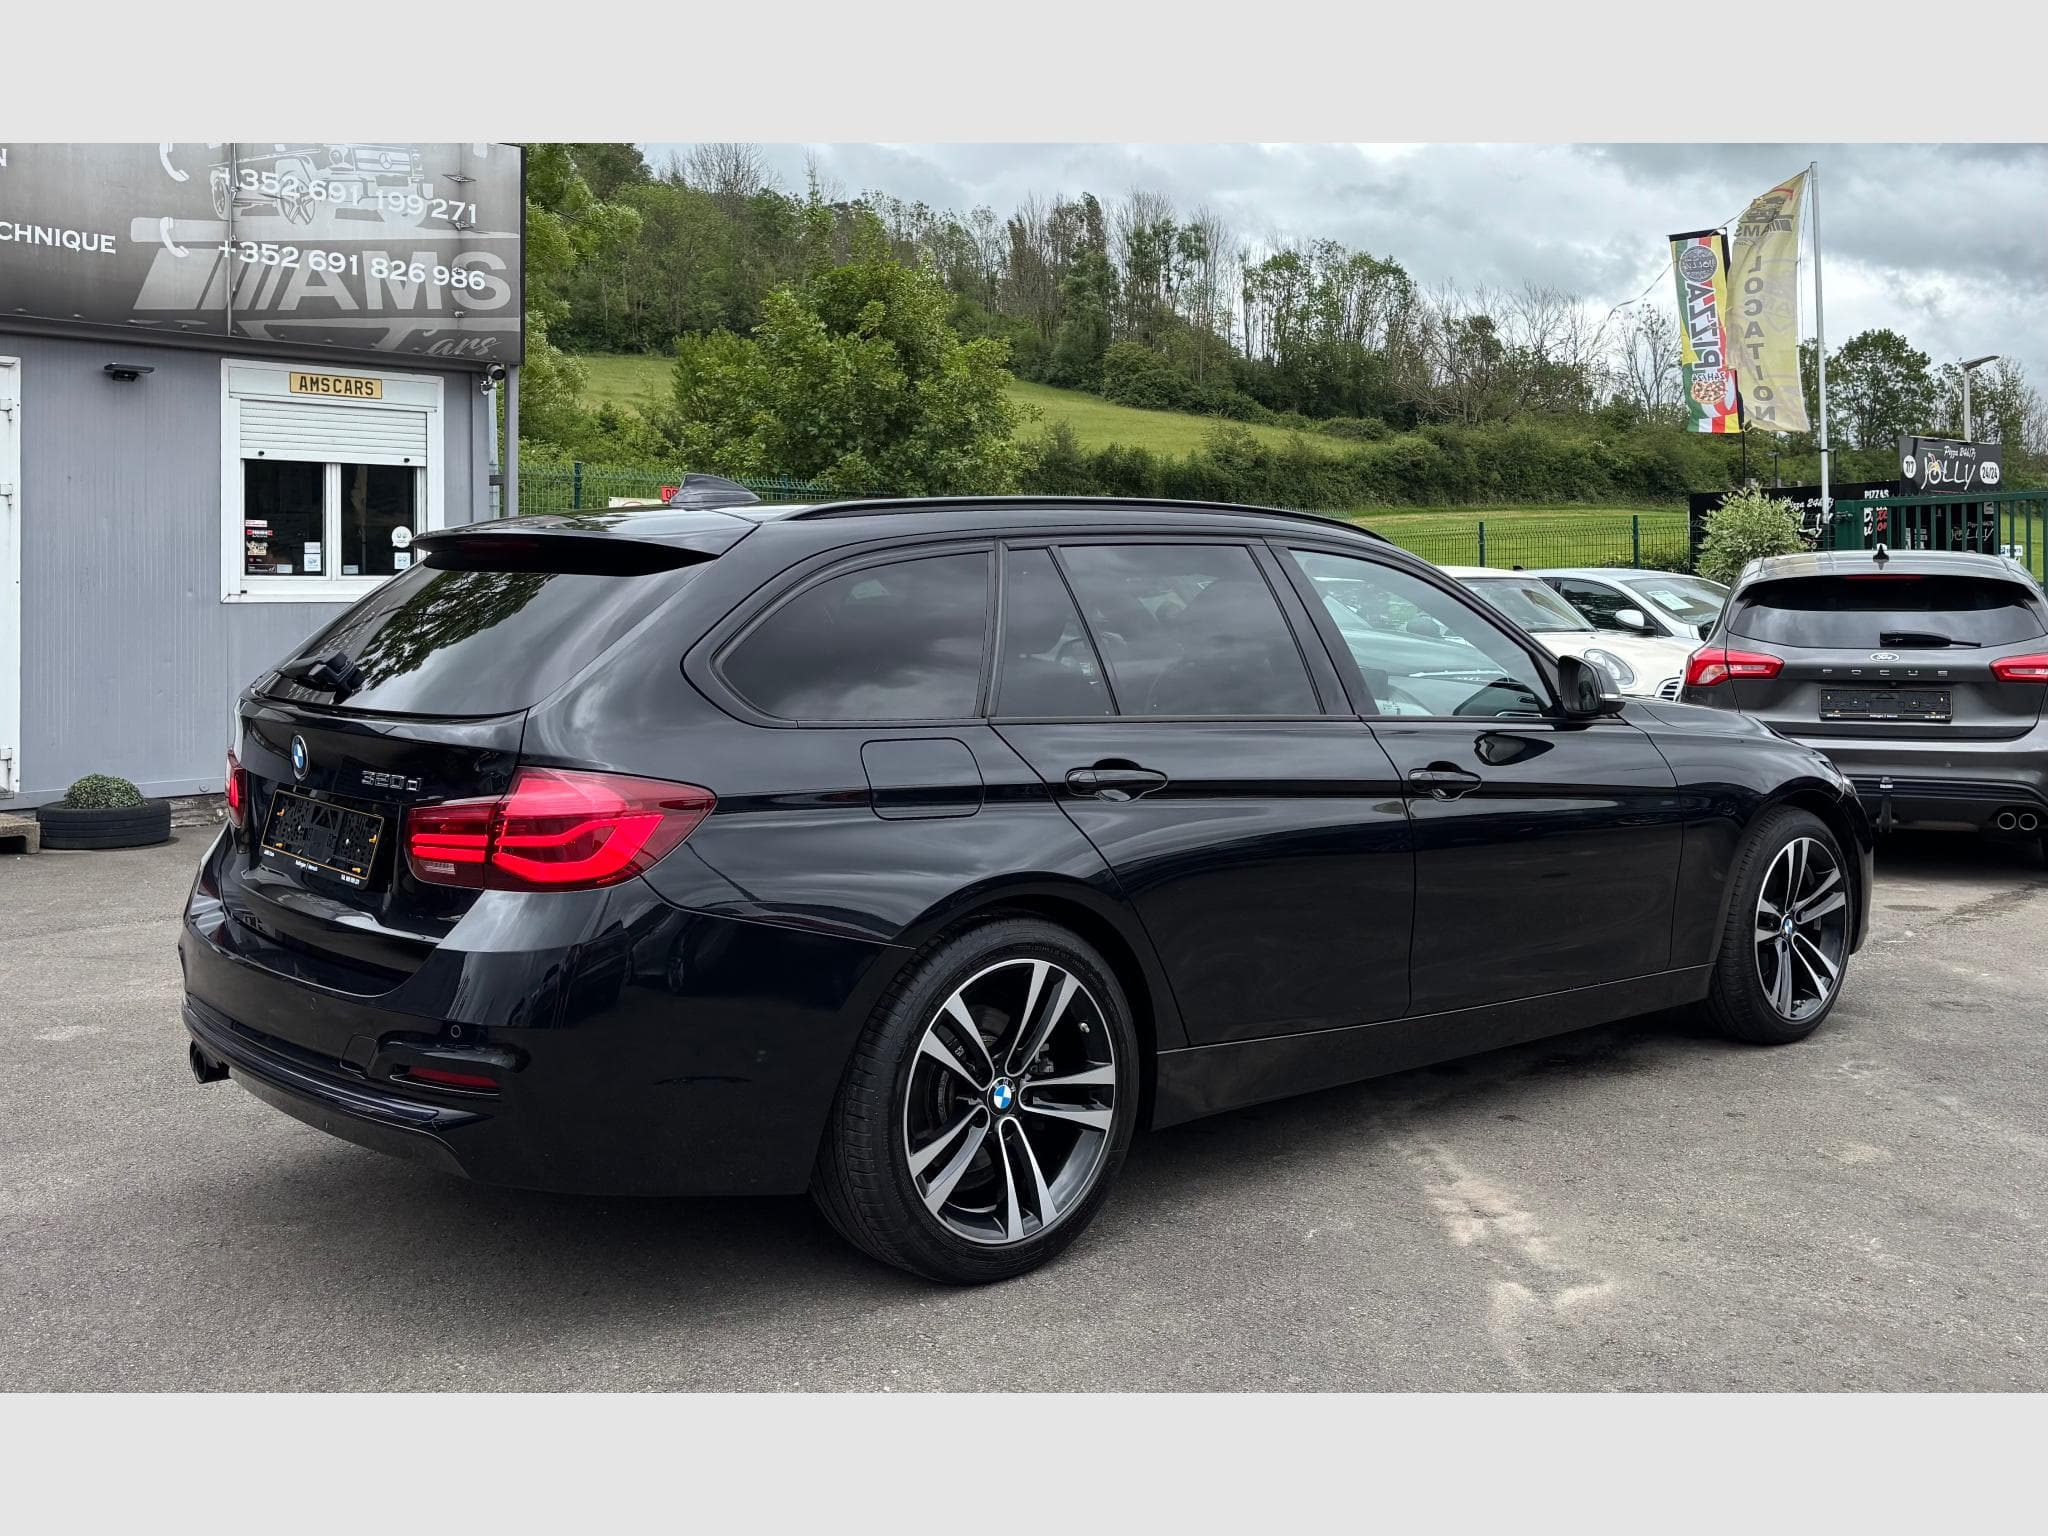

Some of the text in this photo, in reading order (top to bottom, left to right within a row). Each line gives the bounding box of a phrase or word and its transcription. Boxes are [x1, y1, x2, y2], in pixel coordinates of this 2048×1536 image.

[308, 180, 358, 206] 691
[376, 189, 424, 214] 199
[431, 198, 476, 224] 271
[0, 221, 116, 254] CHNIQUE
[308, 250, 358, 276] 691
[370, 257, 426, 283] 826
[432, 265, 486, 290] 986
